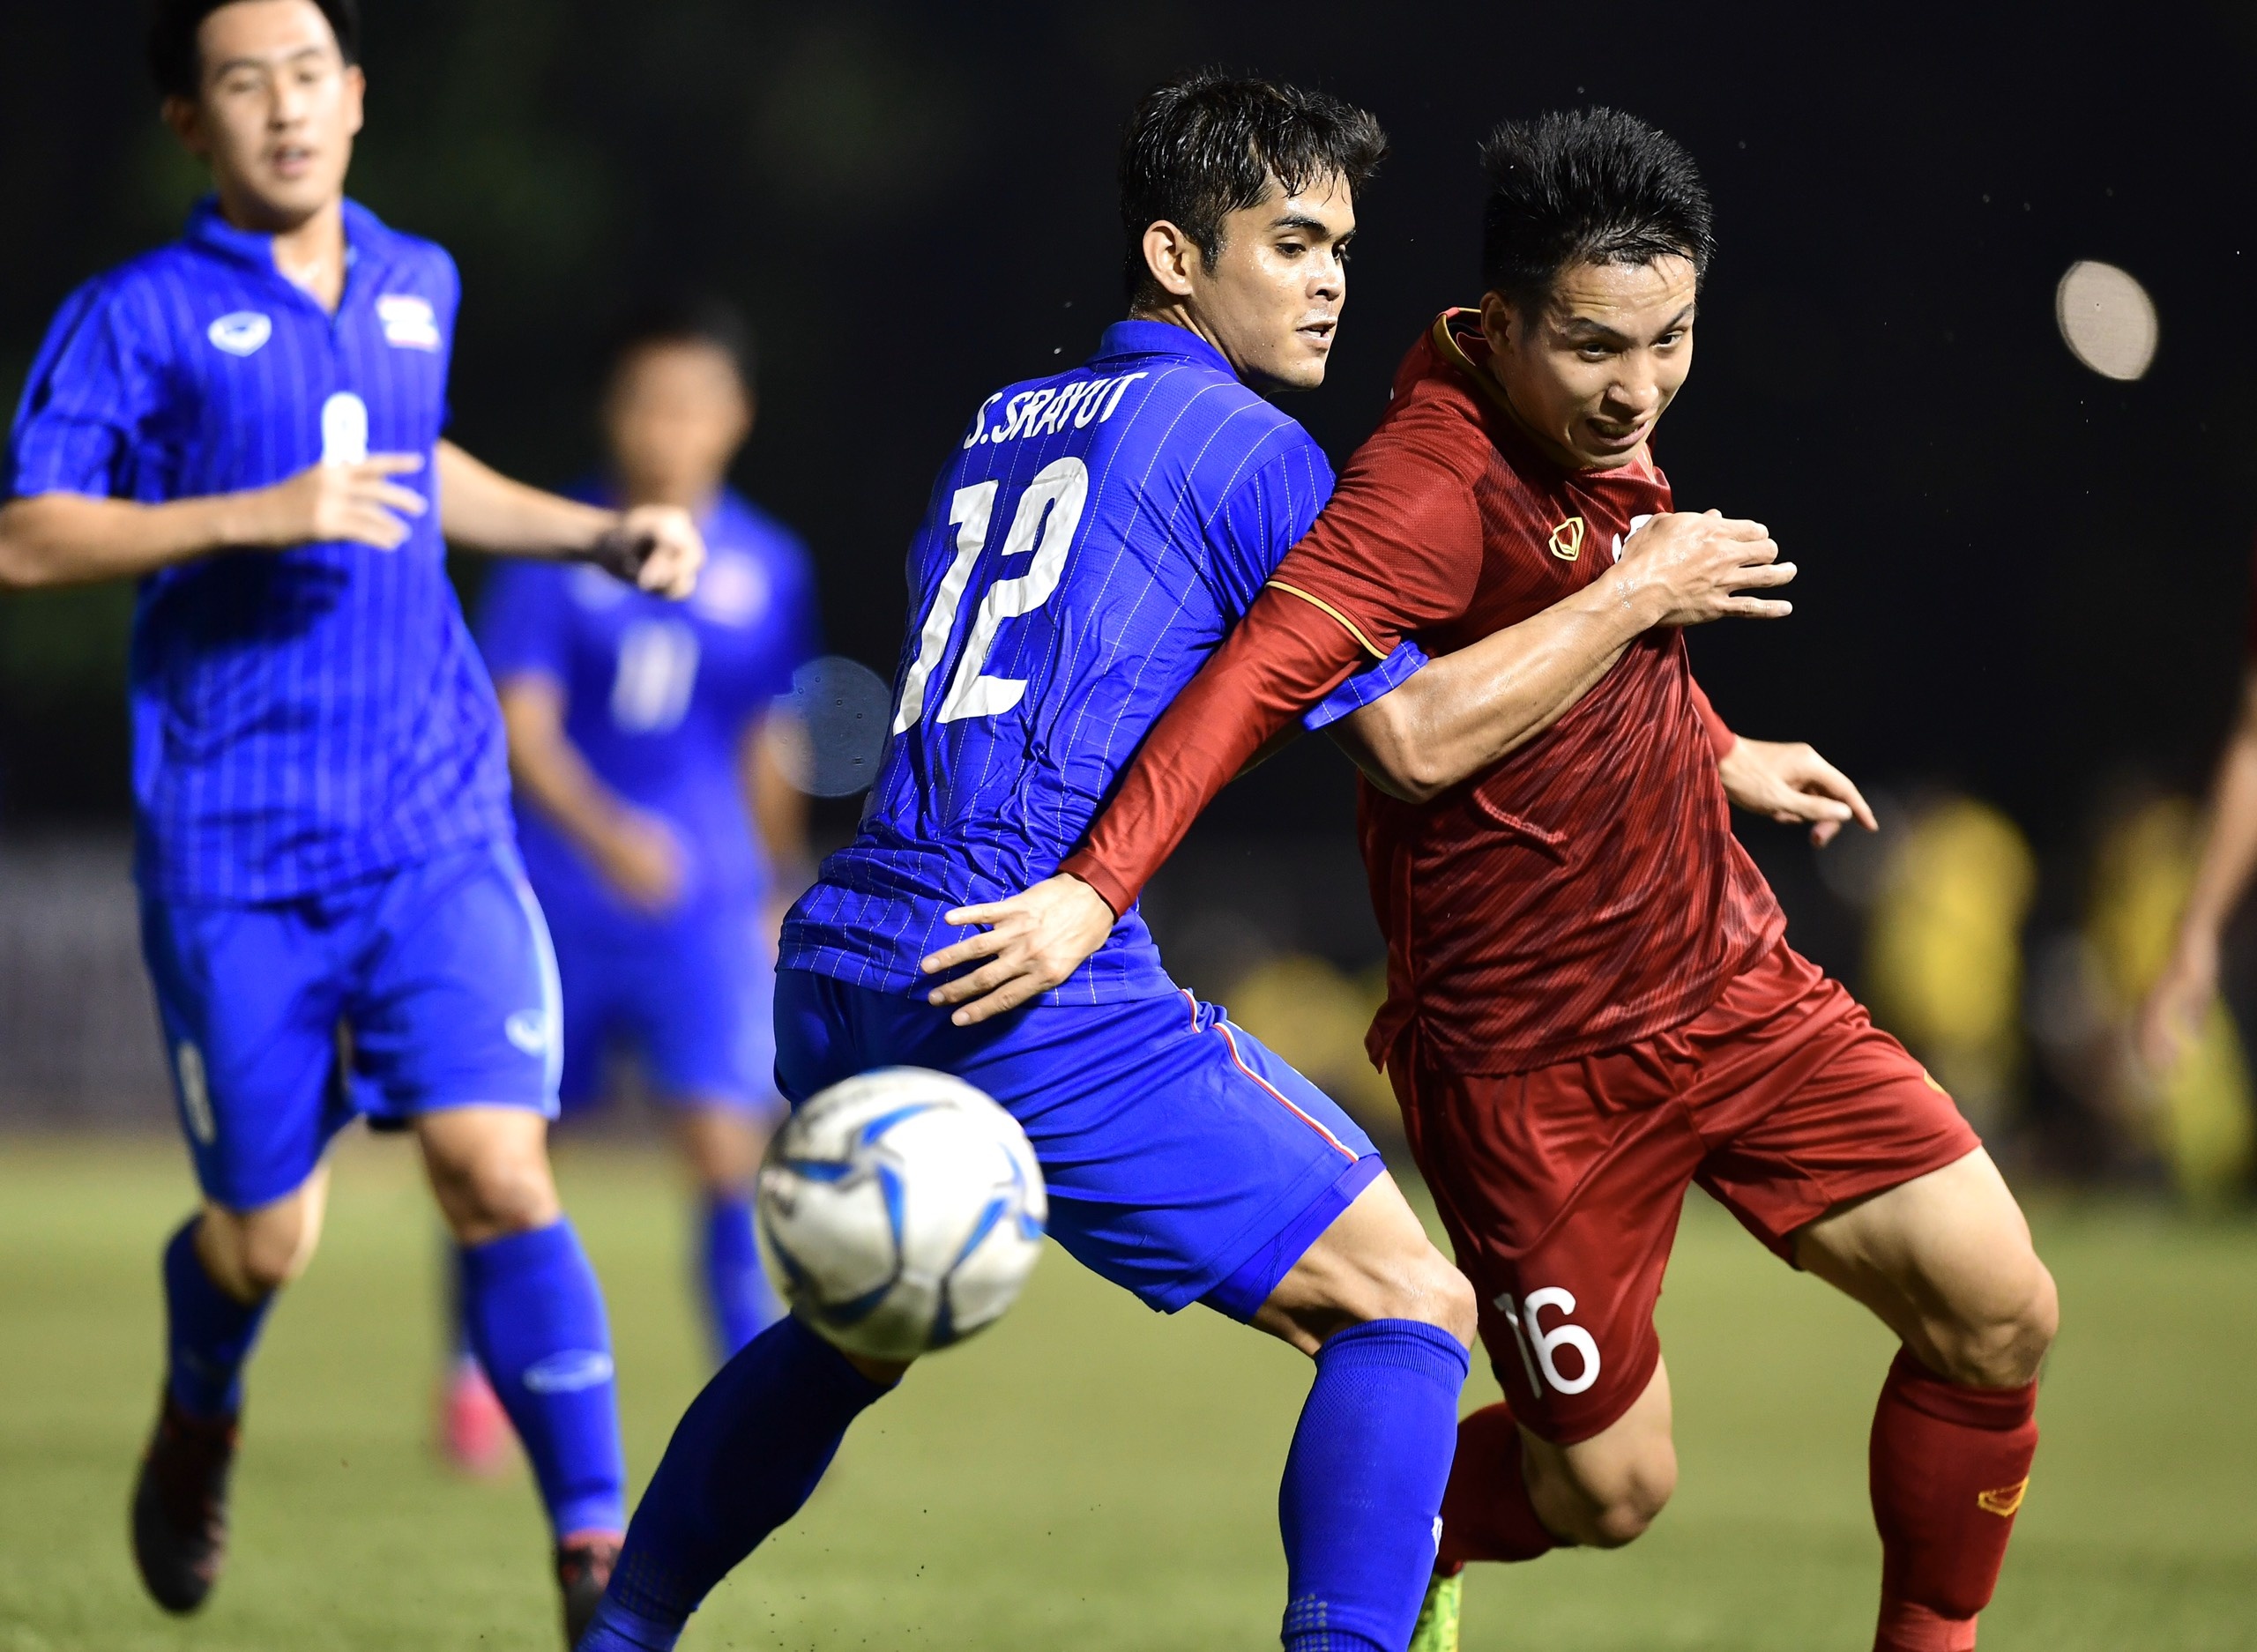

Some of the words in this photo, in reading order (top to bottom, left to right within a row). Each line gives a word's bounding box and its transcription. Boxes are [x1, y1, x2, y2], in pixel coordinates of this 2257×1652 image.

[963, 372, 1149, 450] S.SRAYUT
[893, 457, 1089, 737] 12
[1493, 1286, 1601, 1400] 16
